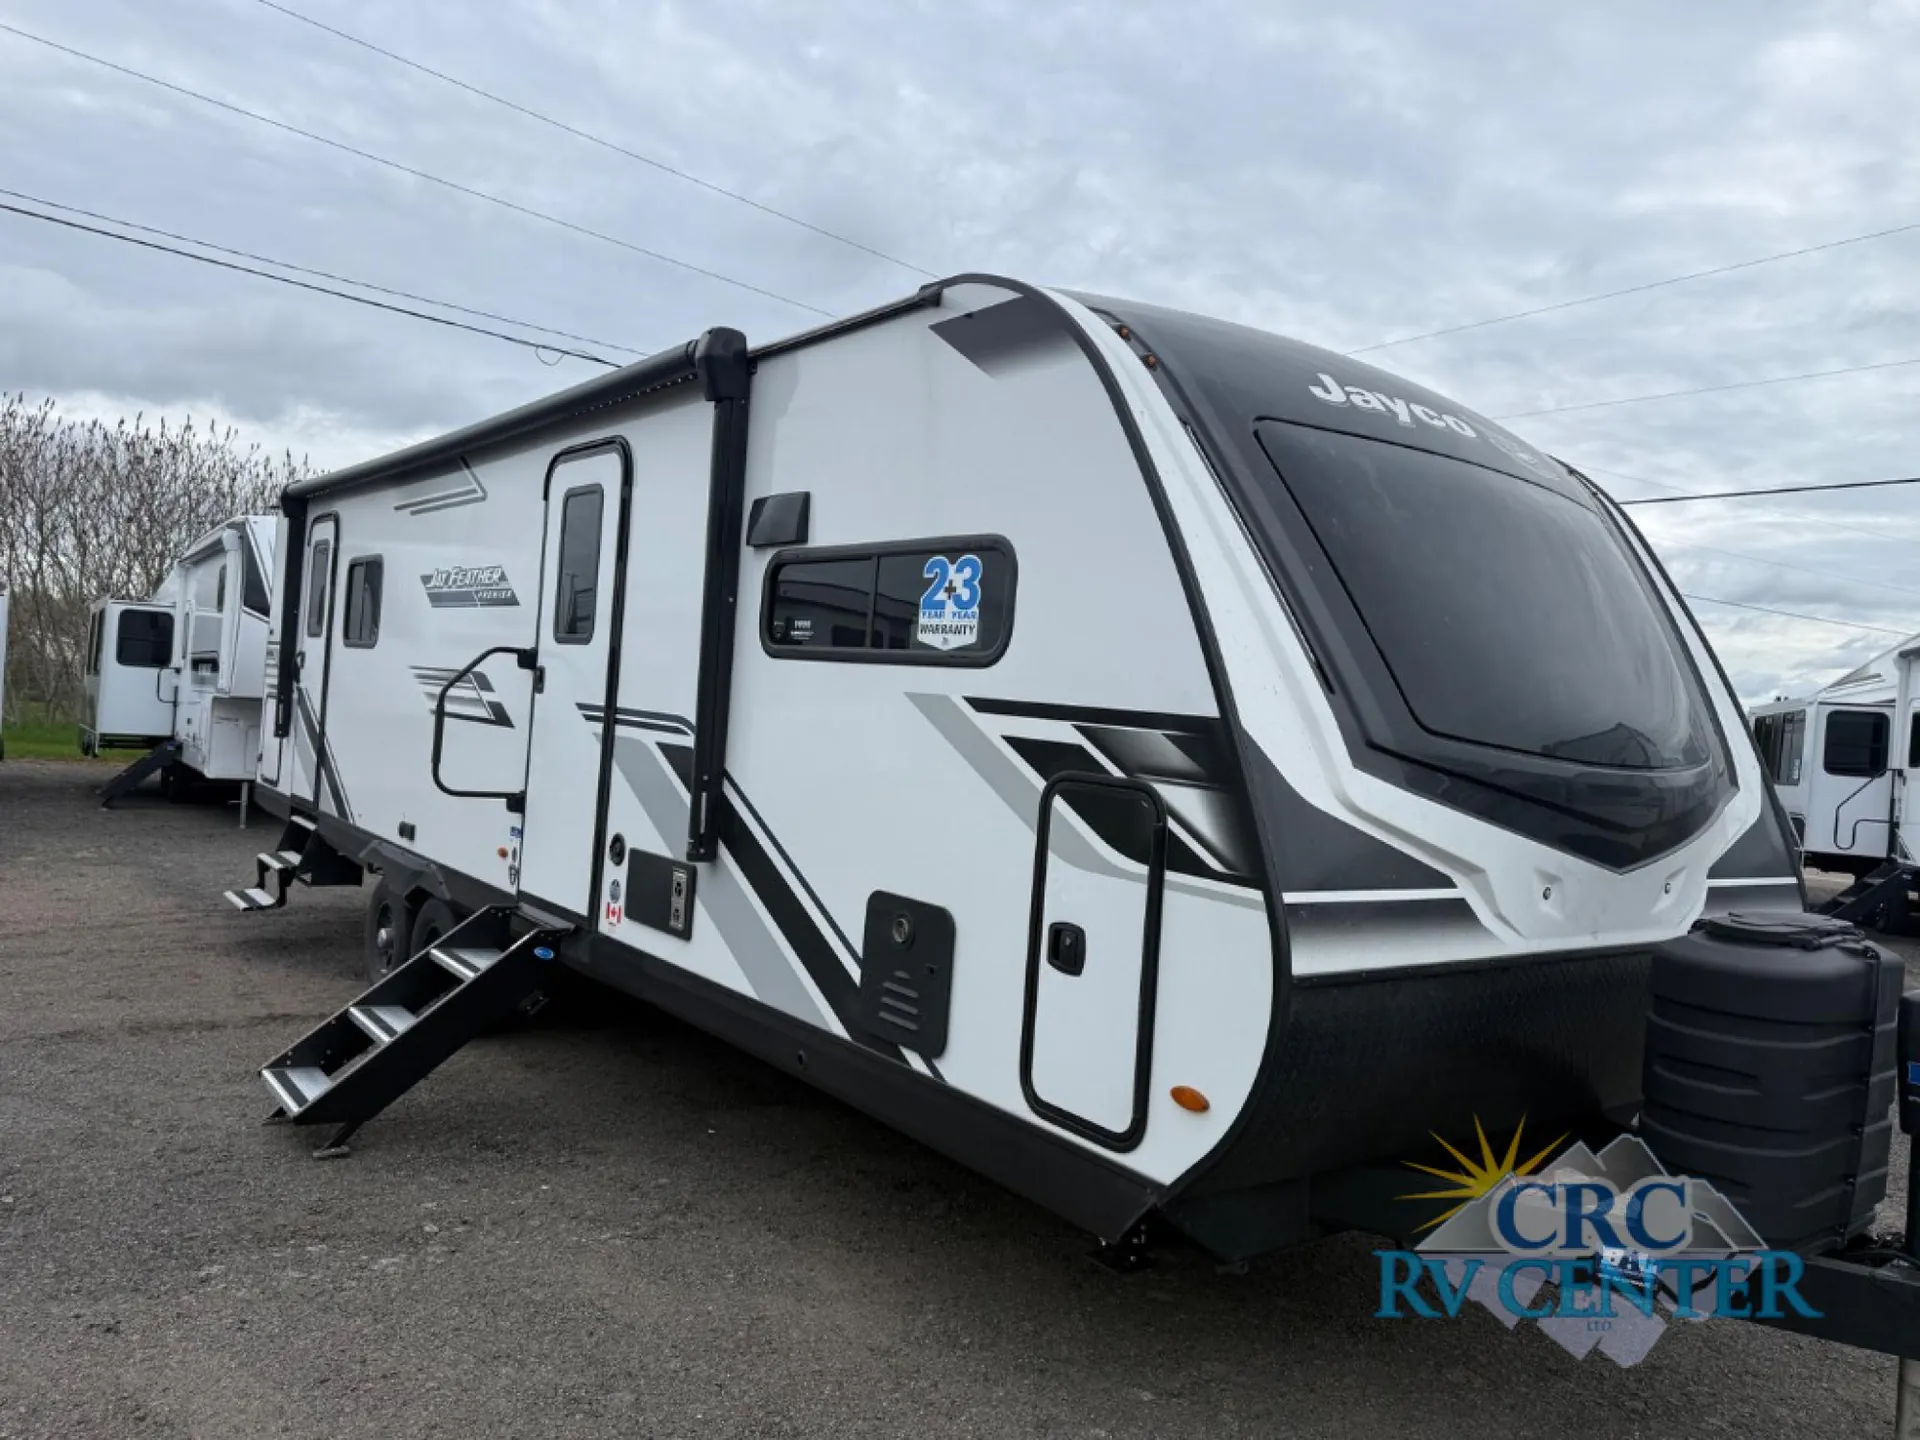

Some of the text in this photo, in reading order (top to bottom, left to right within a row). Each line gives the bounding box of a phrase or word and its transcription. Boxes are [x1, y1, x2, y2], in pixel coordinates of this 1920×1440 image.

[1308, 372, 1477, 438] Jayco
[922, 610, 977, 620] YEAR YEAR
[920, 624, 976, 635] WARRANTY
